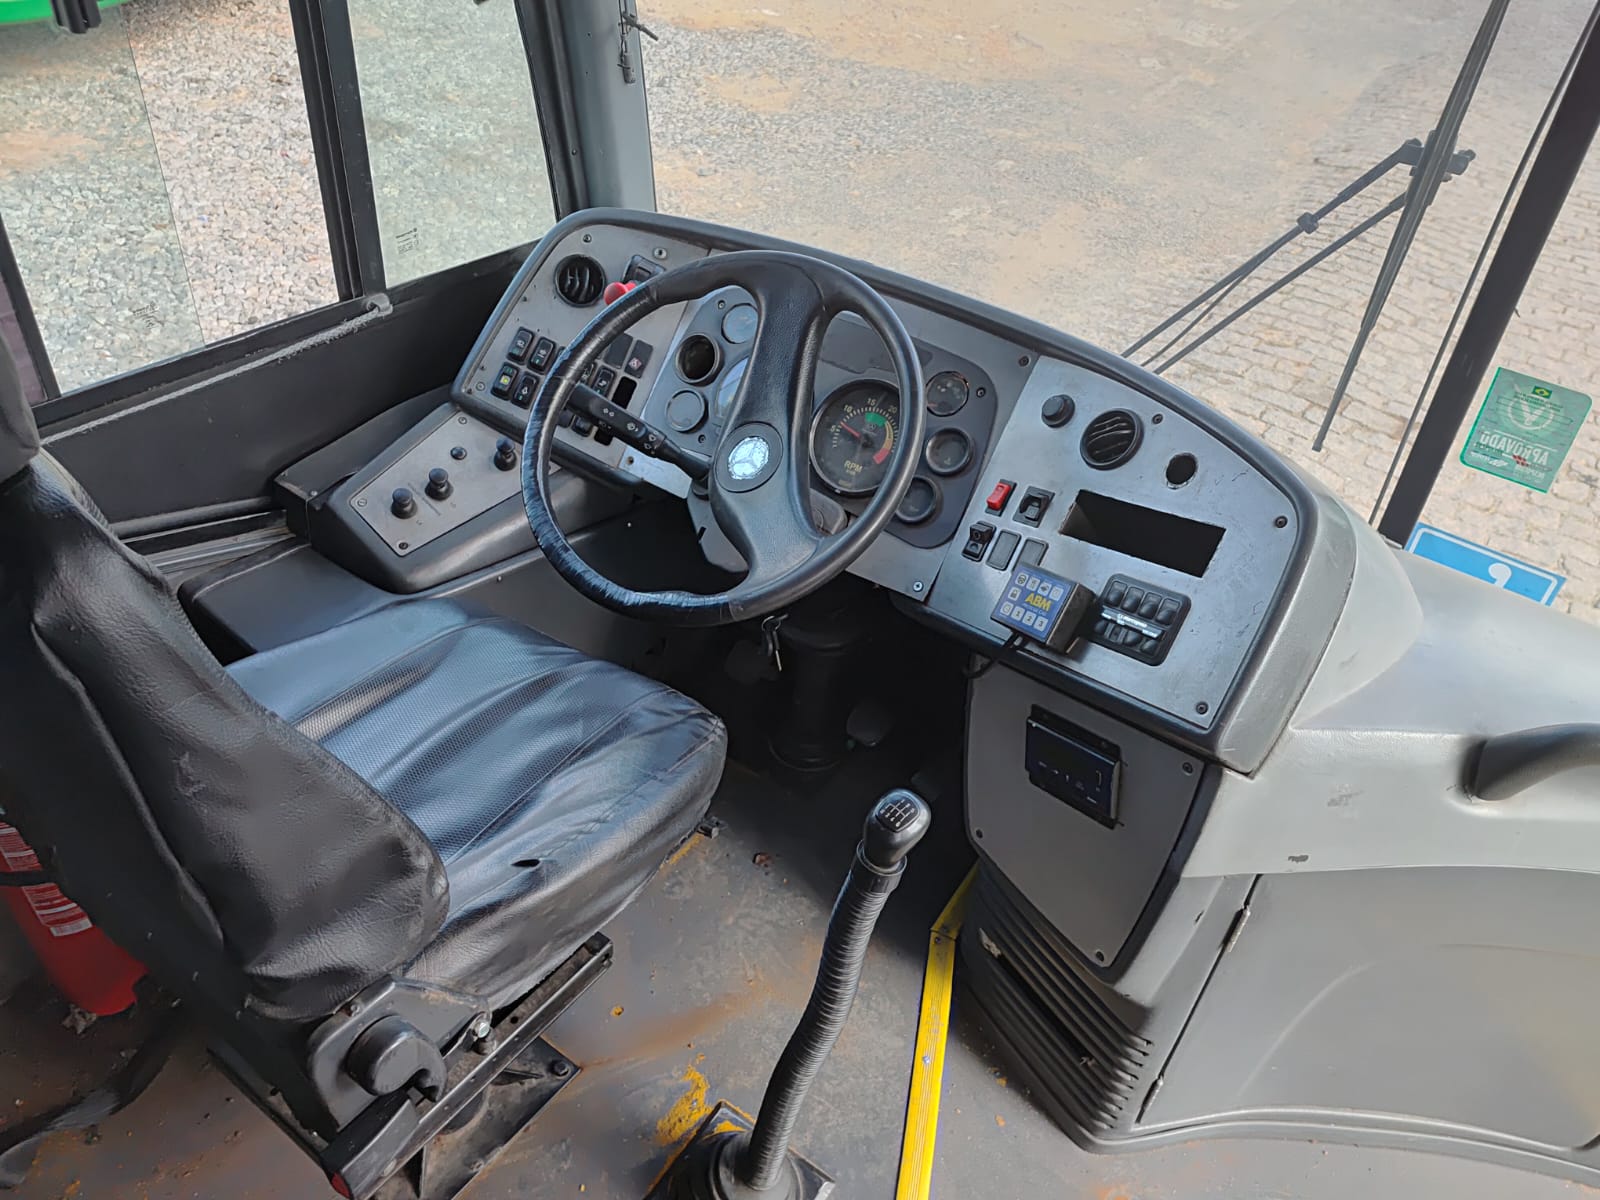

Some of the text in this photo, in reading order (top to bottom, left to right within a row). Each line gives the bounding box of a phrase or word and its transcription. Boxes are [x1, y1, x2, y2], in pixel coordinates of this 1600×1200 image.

[867, 397, 877, 407] 15
[843, 404, 853, 413] 10
[888, 405, 898, 414] 20
[830, 424, 837, 433] 5
[844, 460, 863, 473] RPM
[1025, 592, 1052, 612] ABM
